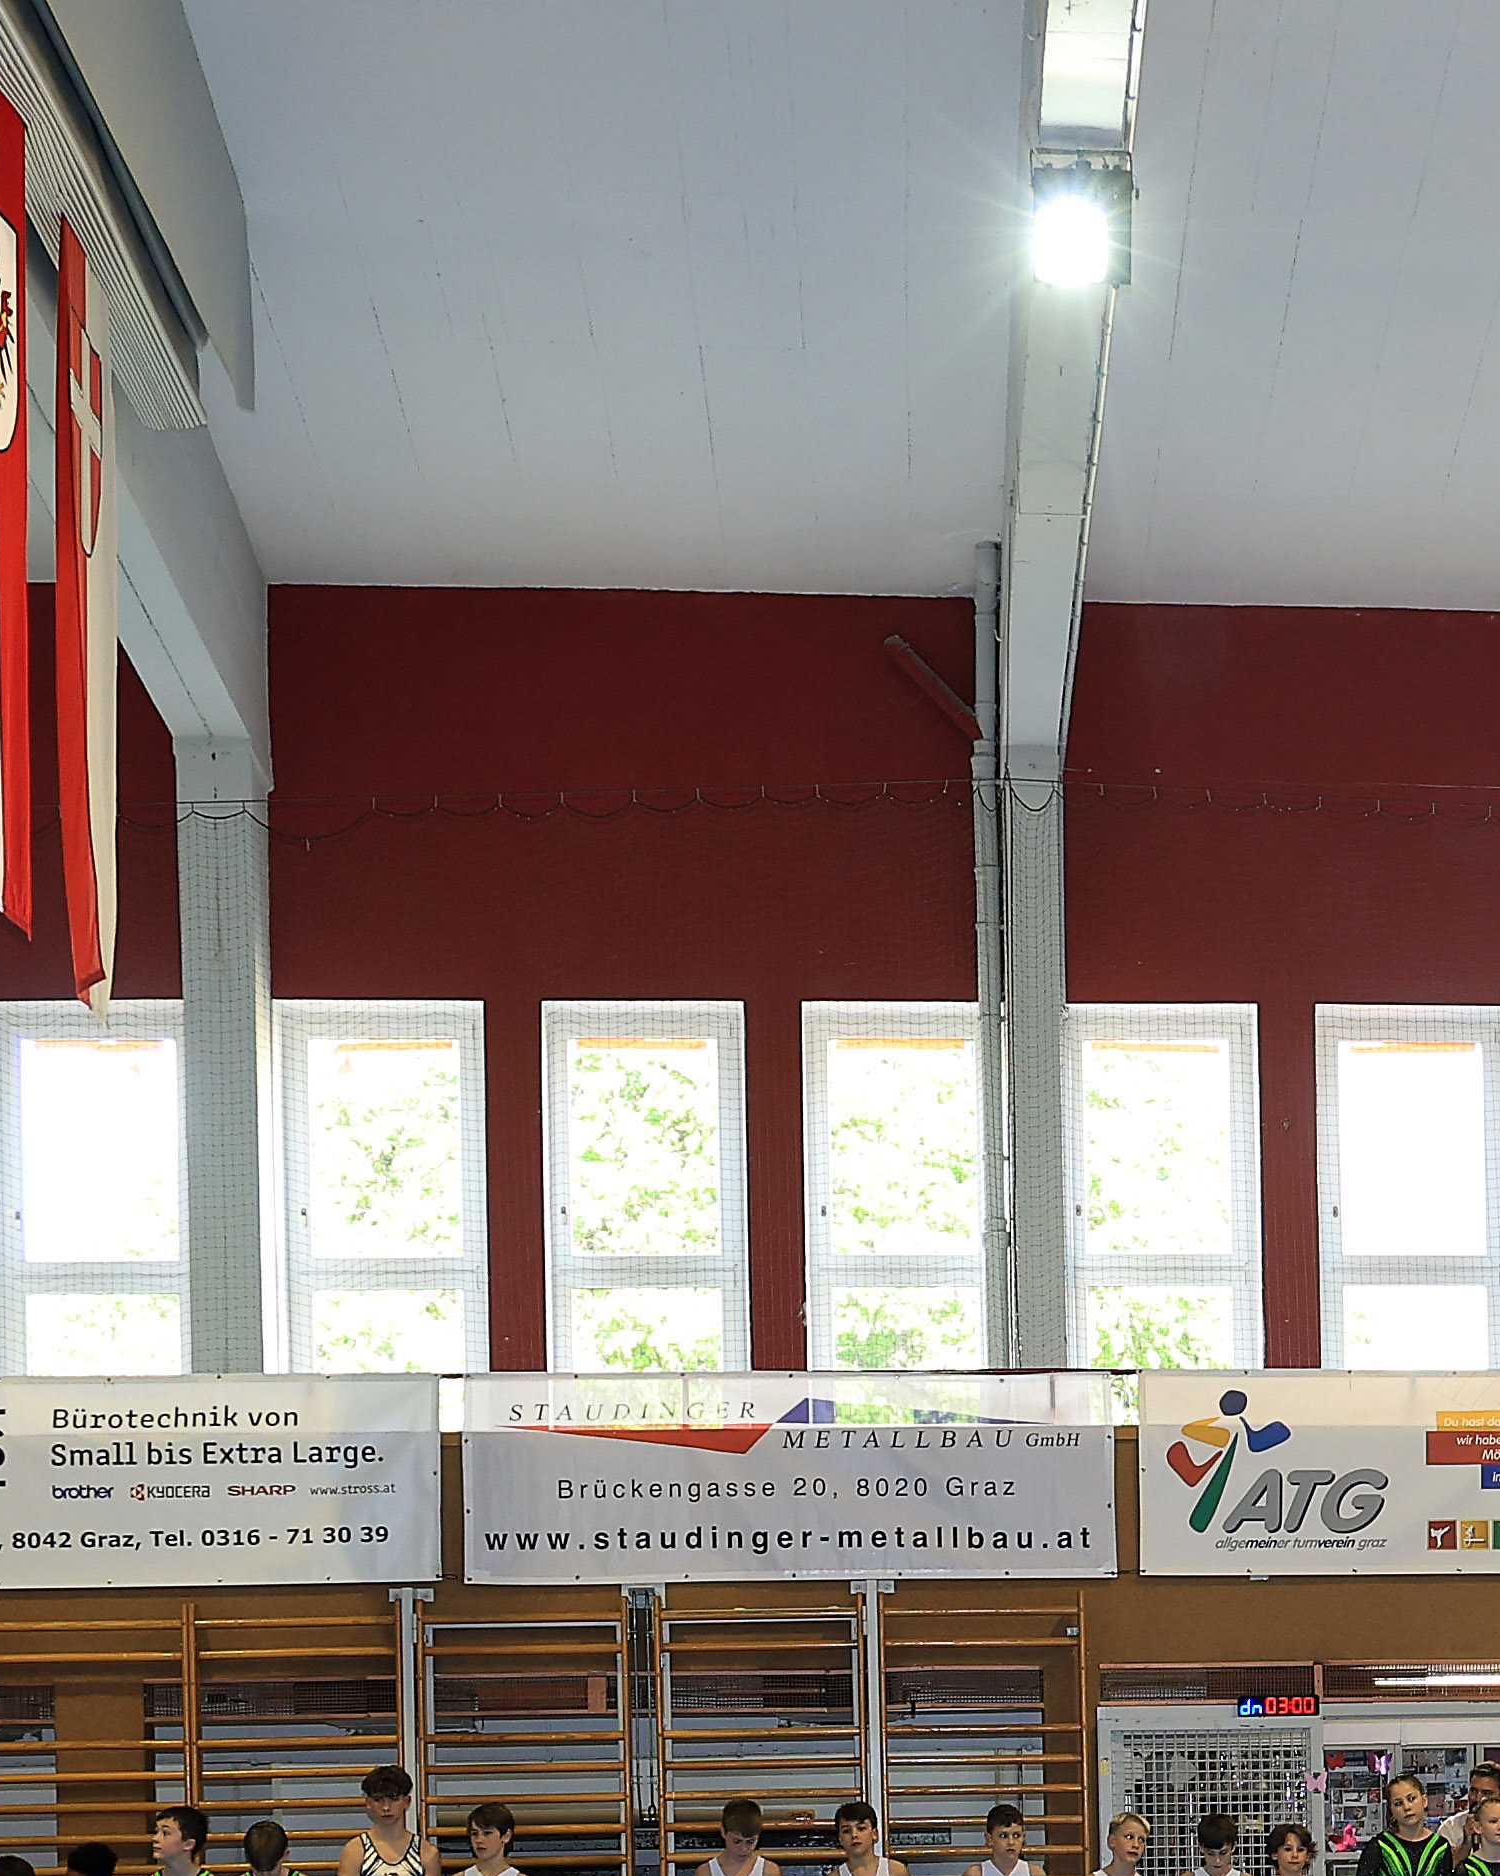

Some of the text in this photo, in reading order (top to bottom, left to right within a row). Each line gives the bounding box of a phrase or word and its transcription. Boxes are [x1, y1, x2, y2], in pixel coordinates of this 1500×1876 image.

[53, 1405, 298, 1429] Bürotechnik von
[509, 1401, 755, 1421] STAUDINGER
[1444, 1416, 1459, 1427] Du
[1462, 1416, 1485, 1427] hast
[782, 1429, 1081, 1449] METALLBAU GmbH
[1456, 1435, 1472, 1445] wir
[51, 1442, 384, 1468] Small bis Extra Large.
[52, 1485, 114, 1499] brother
[227, 1484, 296, 1496] SHARP
[310, 1483, 396, 1496] www.stross.at
[558, 1476, 1016, 1502] Brückengasse 20, 8020 Graz
[1222, 1468, 1388, 1534] ATG
[12, 1532, 72, 1549] 8042
[80, 1531, 142, 1551] Graz,
[149, 1530, 193, 1547] Tel.
[201, 1529, 260, 1546] 0316
[287, 1528, 313, 1545] 71
[322, 1527, 352, 1544] 30
[360, 1526, 389, 1543] 39
[485, 1526, 1091, 1555] www.staudinger-metallbau.at
[1215, 1536, 1388, 1551] allgemeiner turnverein graz
[1265, 1696, 1315, 1715] 03:00
